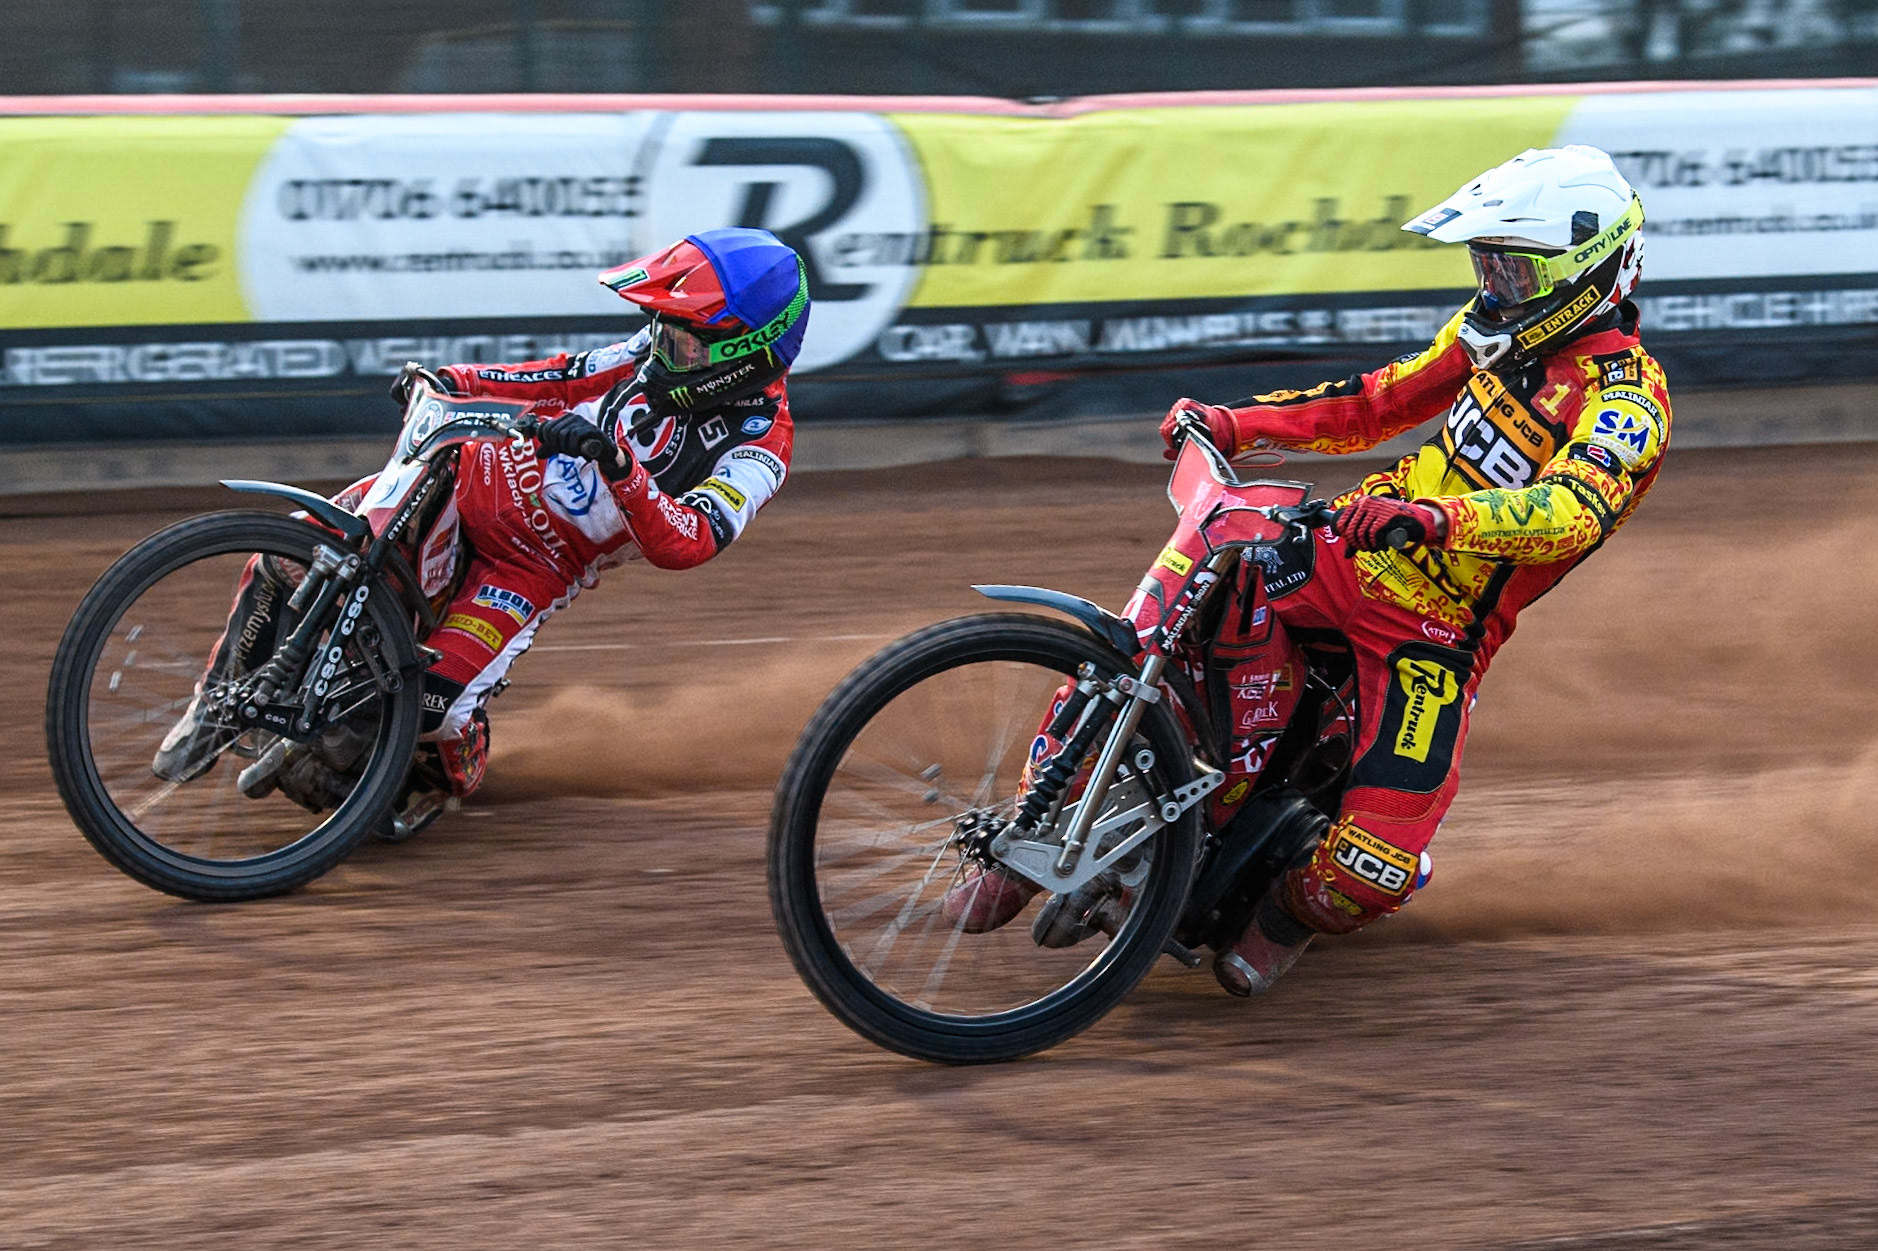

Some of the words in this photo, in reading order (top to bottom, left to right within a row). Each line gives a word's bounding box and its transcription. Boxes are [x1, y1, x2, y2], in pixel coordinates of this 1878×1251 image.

[1544, 292, 1595, 332] ENTRACK
[720, 310, 790, 358] OAKLEY
[696, 364, 756, 394] MONSTER
[1539, 383, 1571, 417] 1
[1602, 391, 1658, 416] MALINIAR
[1447, 394, 1532, 490] JCB
[1513, 419, 1545, 448] JCB
[557, 458, 588, 504] ATPI
[1568, 478, 1607, 518] Tasker
[479, 585, 535, 615] ALBON
[1347, 828, 1391, 856] WATLING
[1390, 851, 1411, 865] JCB
[1335, 847, 1407, 892] JCB
